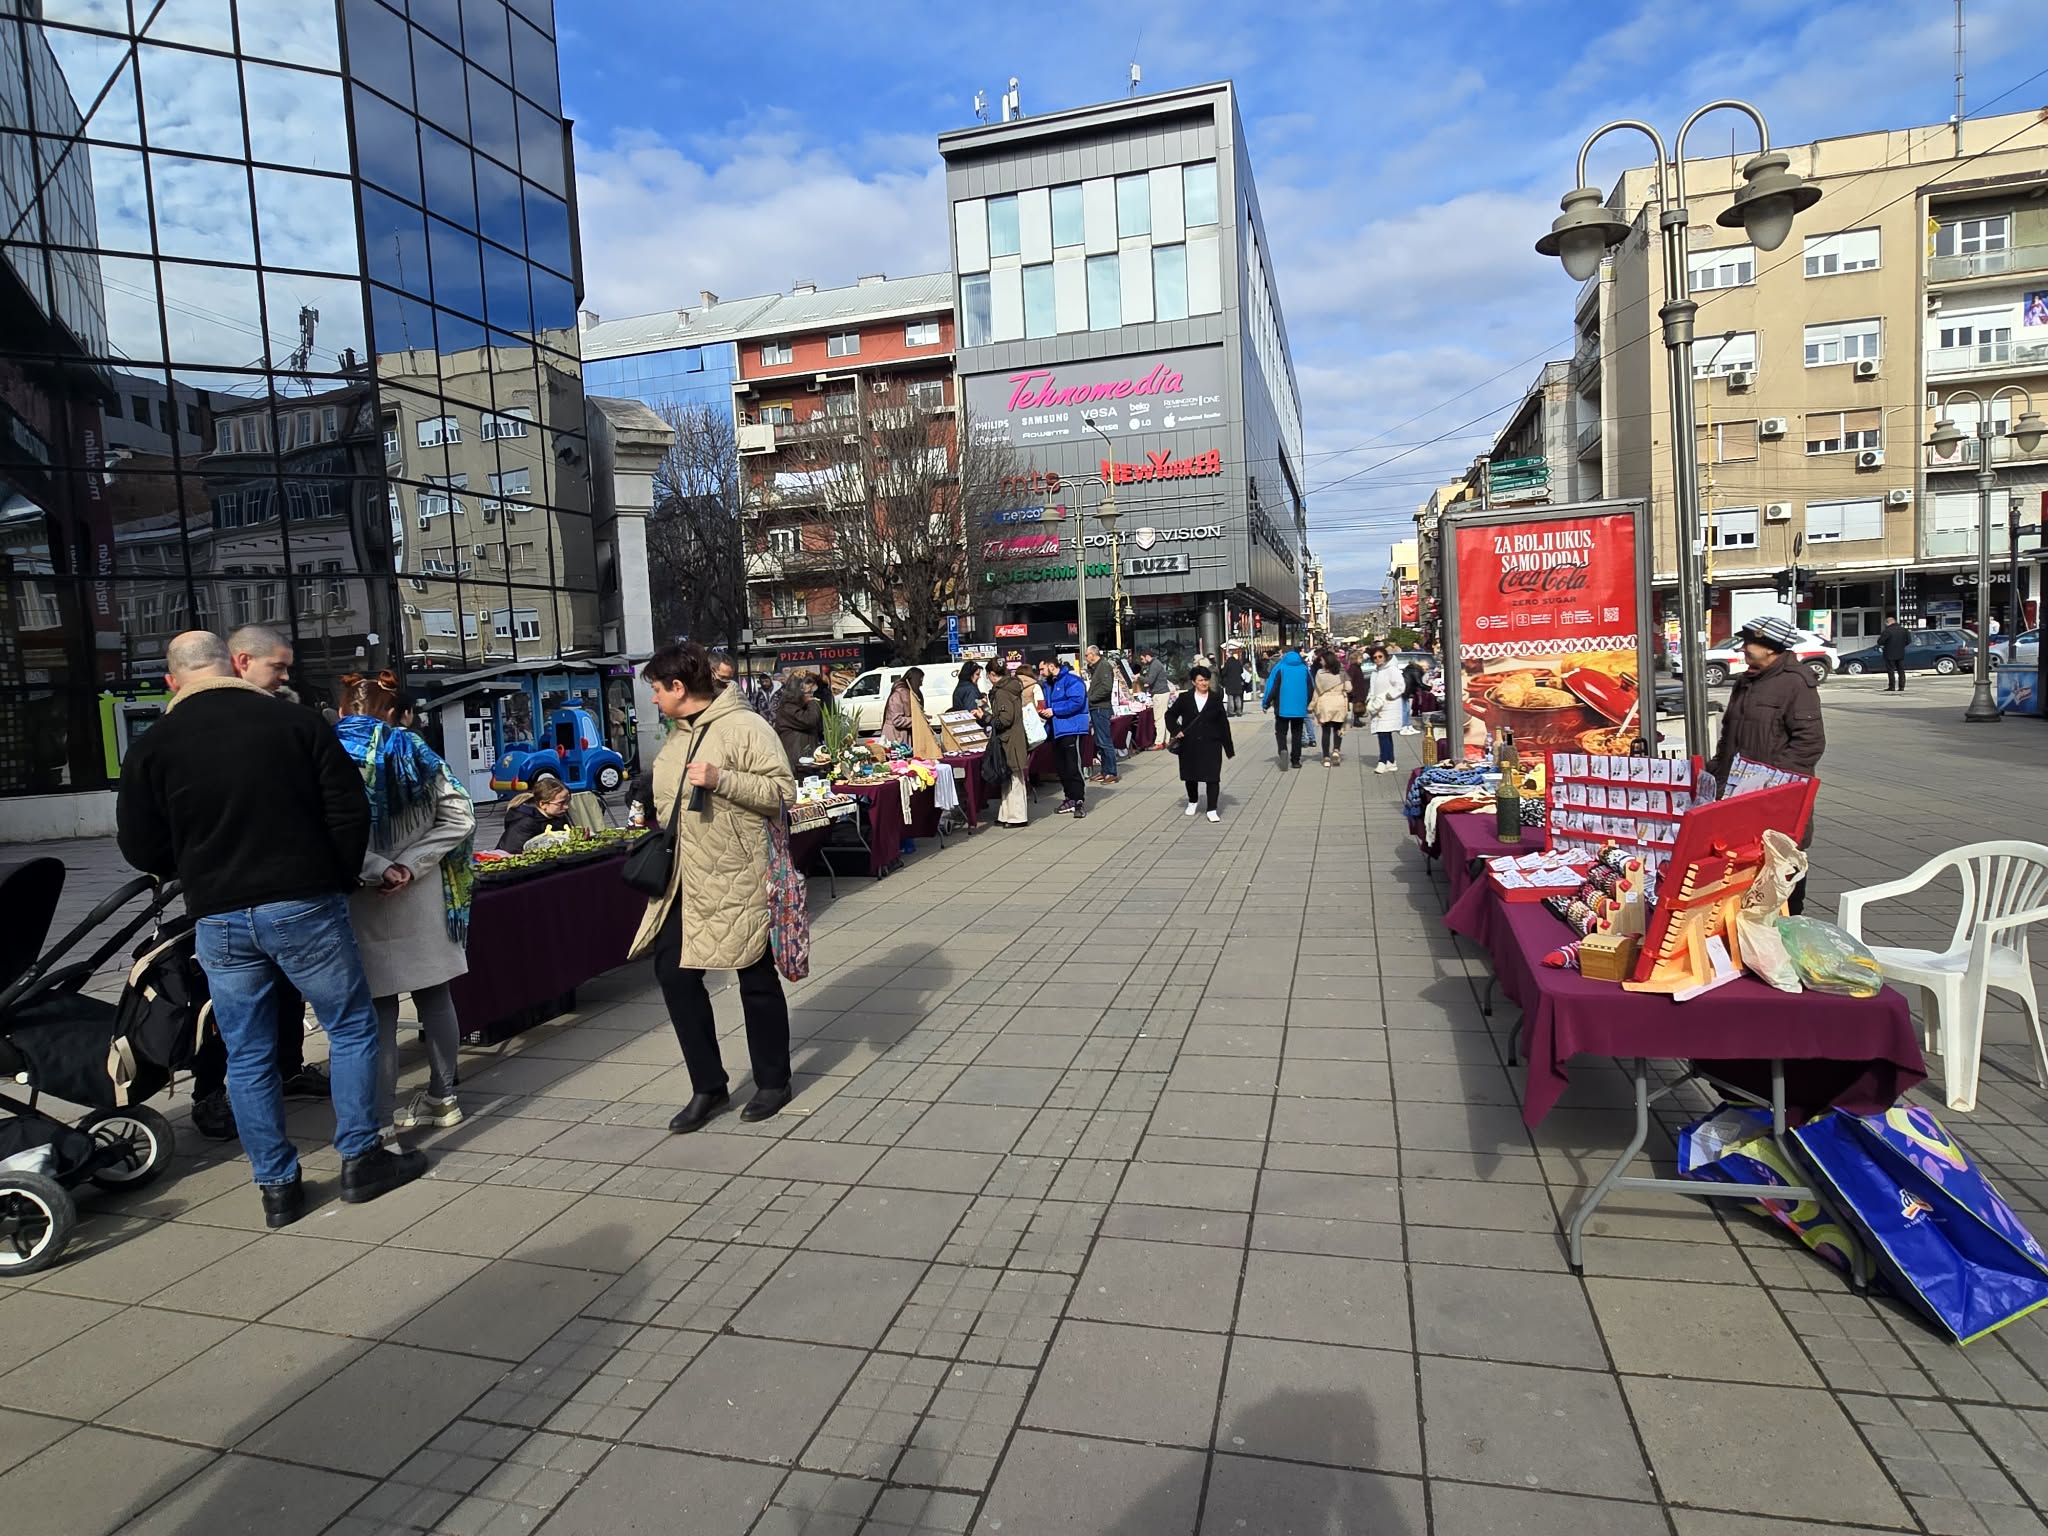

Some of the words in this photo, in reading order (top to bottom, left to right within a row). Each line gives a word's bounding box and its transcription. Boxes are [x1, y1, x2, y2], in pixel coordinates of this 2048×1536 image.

[1007, 362, 1183, 411] Tehnomedia
[1129, 402, 1150, 412] beko
[975, 419, 1009, 431] PHILIPS
[1021, 412, 1069, 426] SAMSUNG
[1161, 525, 1222, 541] VISION
[1494, 536, 1511, 554] ZA
[1514, 532, 1553, 553] BOLJI
[1556, 529, 1596, 549] UKUS,
[1132, 557, 1179, 573] BUZZ
[1501, 552, 1540, 573] SAMO
[1543, 549, 1590, 570] DODAJ
[1512, 598, 1538, 607] ZERO
[1542, 596, 1577, 605] SUGAR
[949, 618, 956, 631] P
[780, 651, 814, 661] PIZZA
[820, 648, 860, 659] HOUSE
